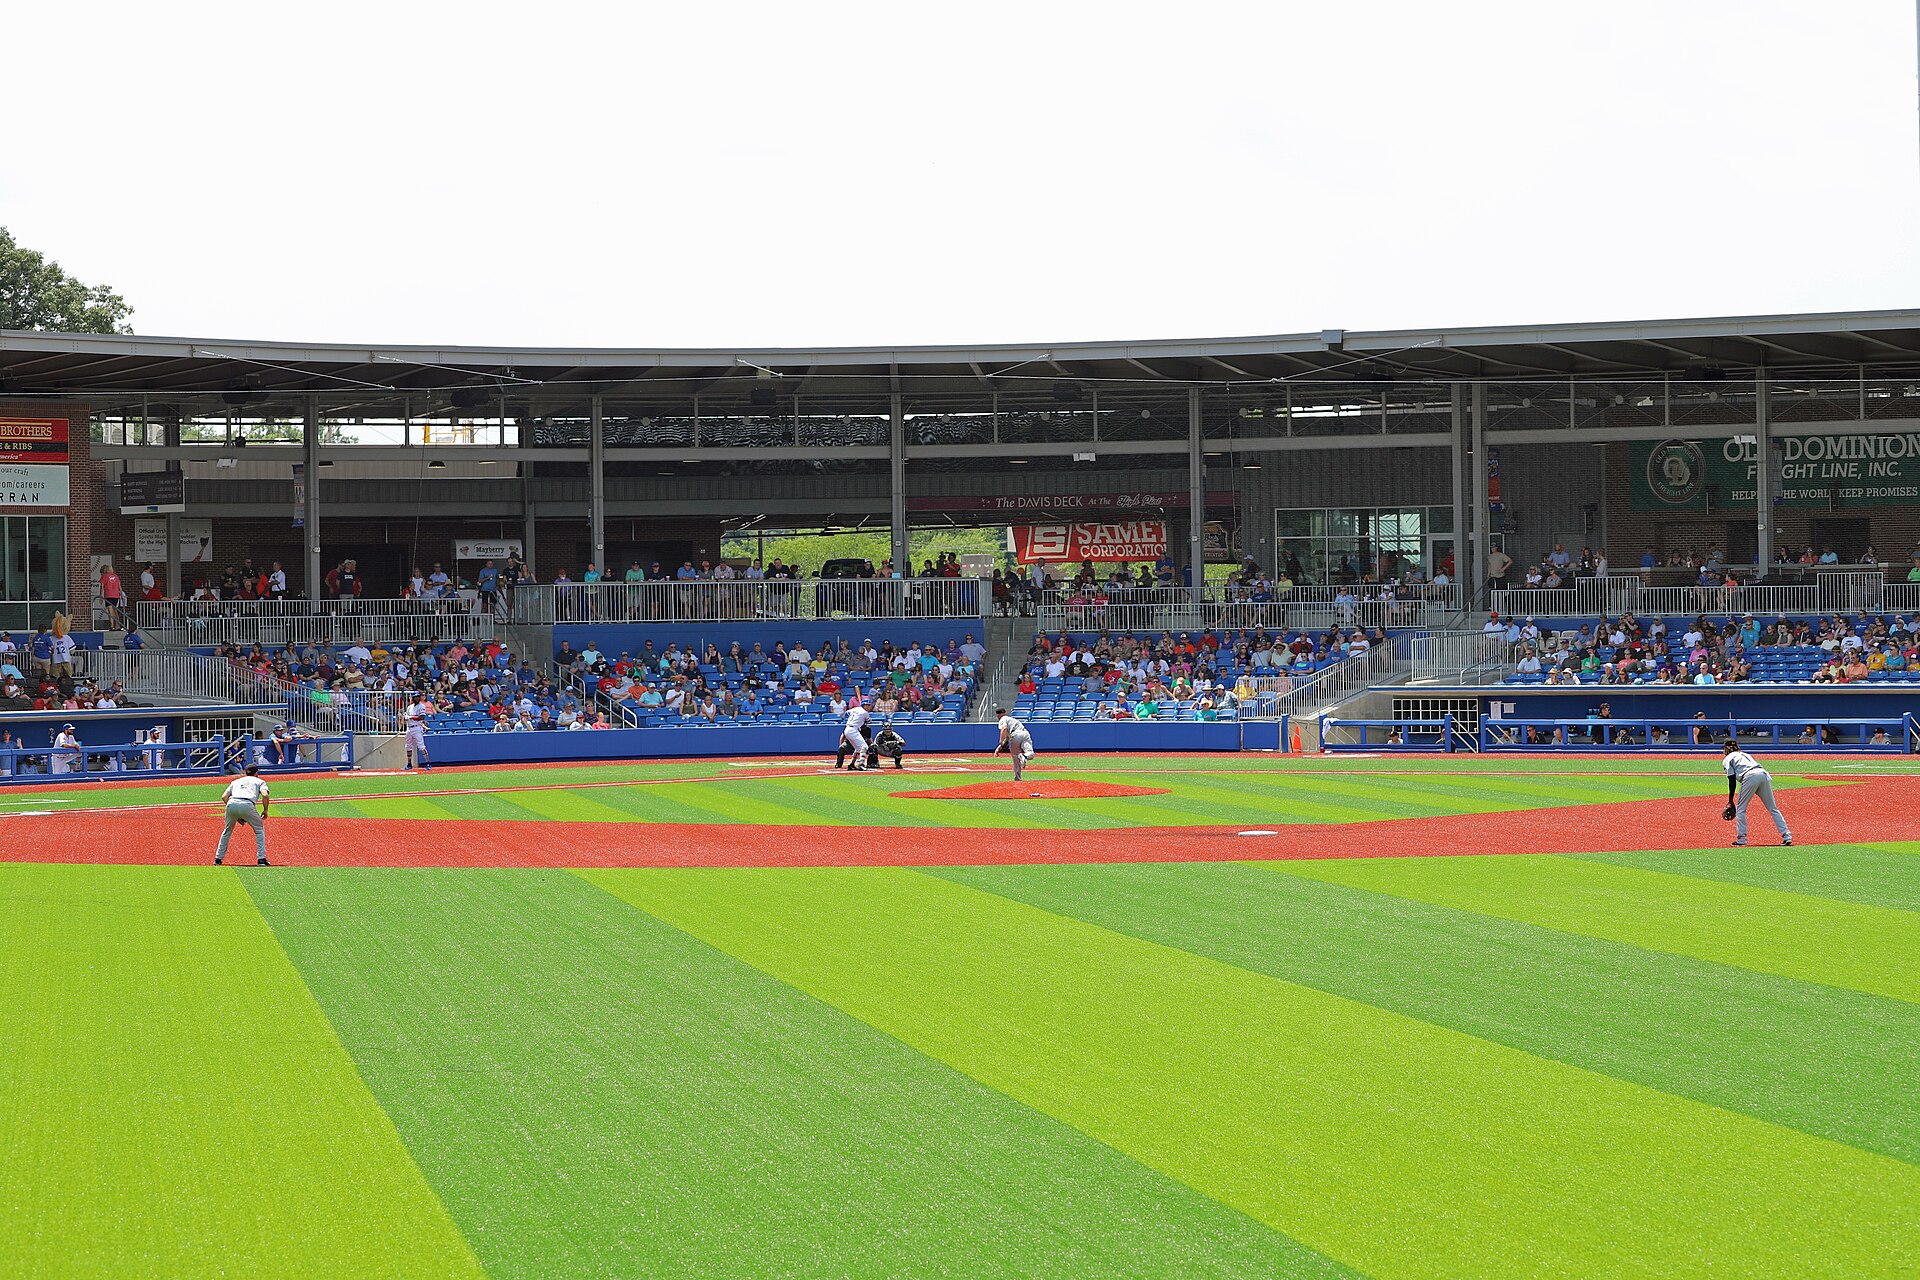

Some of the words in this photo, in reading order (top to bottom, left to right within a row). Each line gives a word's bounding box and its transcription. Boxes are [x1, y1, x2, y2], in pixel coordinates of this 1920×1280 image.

[1, 426, 53, 437] BROTHERS
[13, 442, 33, 450] RIBS
[1723, 438, 1757, 462] OL
[14, 468, 29, 476] craft
[1821, 462, 1862, 479] LINE,
[1868, 461, 1902, 477] INC.
[1839, 489, 1864, 498] KEEP
[1866, 487, 1918, 497] PROMISES
[996, 498, 1014, 508] The
[1018, 497, 1051, 507] DAVIS
[1054, 496, 1083, 507] DECK
